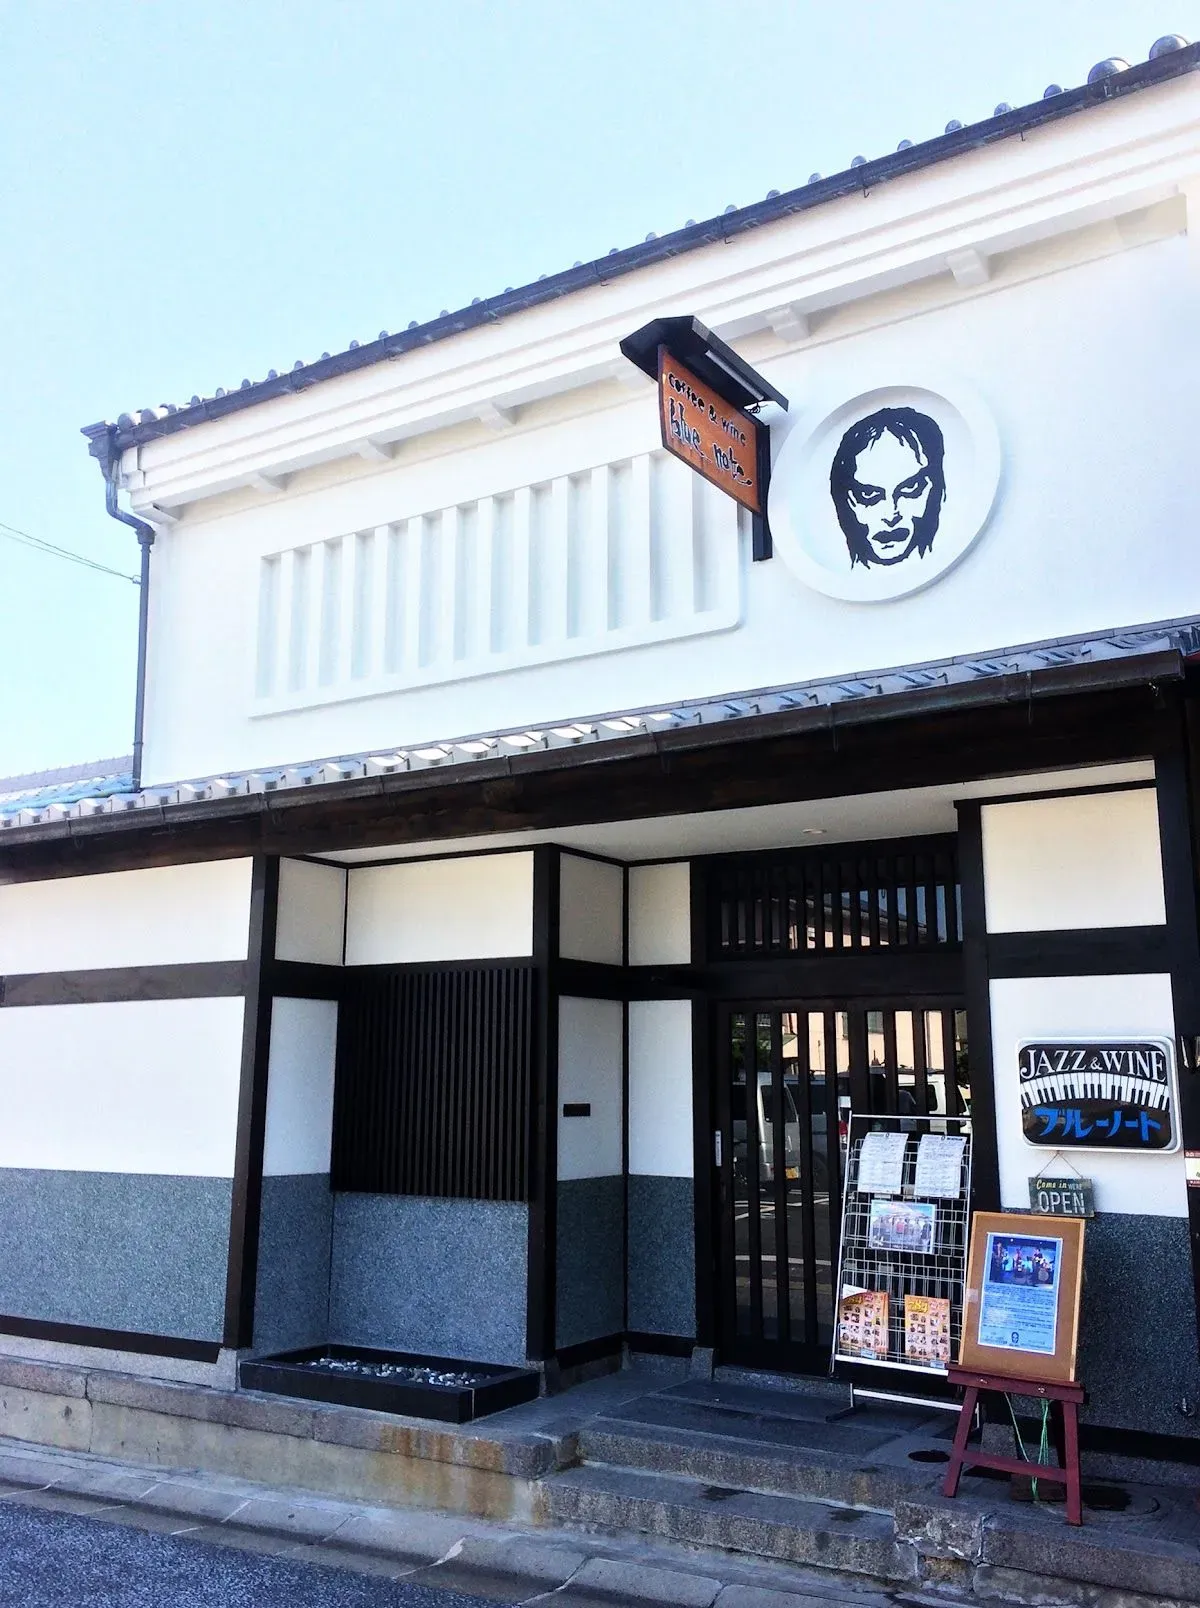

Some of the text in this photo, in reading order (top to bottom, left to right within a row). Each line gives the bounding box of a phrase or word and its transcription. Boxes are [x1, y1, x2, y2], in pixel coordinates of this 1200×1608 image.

[668, 372, 746, 447] coffee & wine
[669, 396, 753, 487] blue note
[1020, 1049, 1087, 1079] JAZZ
[1100, 1050, 1167, 1082] WINE
[1032, 1106, 1161, 1141] ブルーノート
[1036, 1179, 1057, 1190] Come
[1058, 1180, 1068, 1189] in
[1039, 1190, 1085, 1214] OPEN
